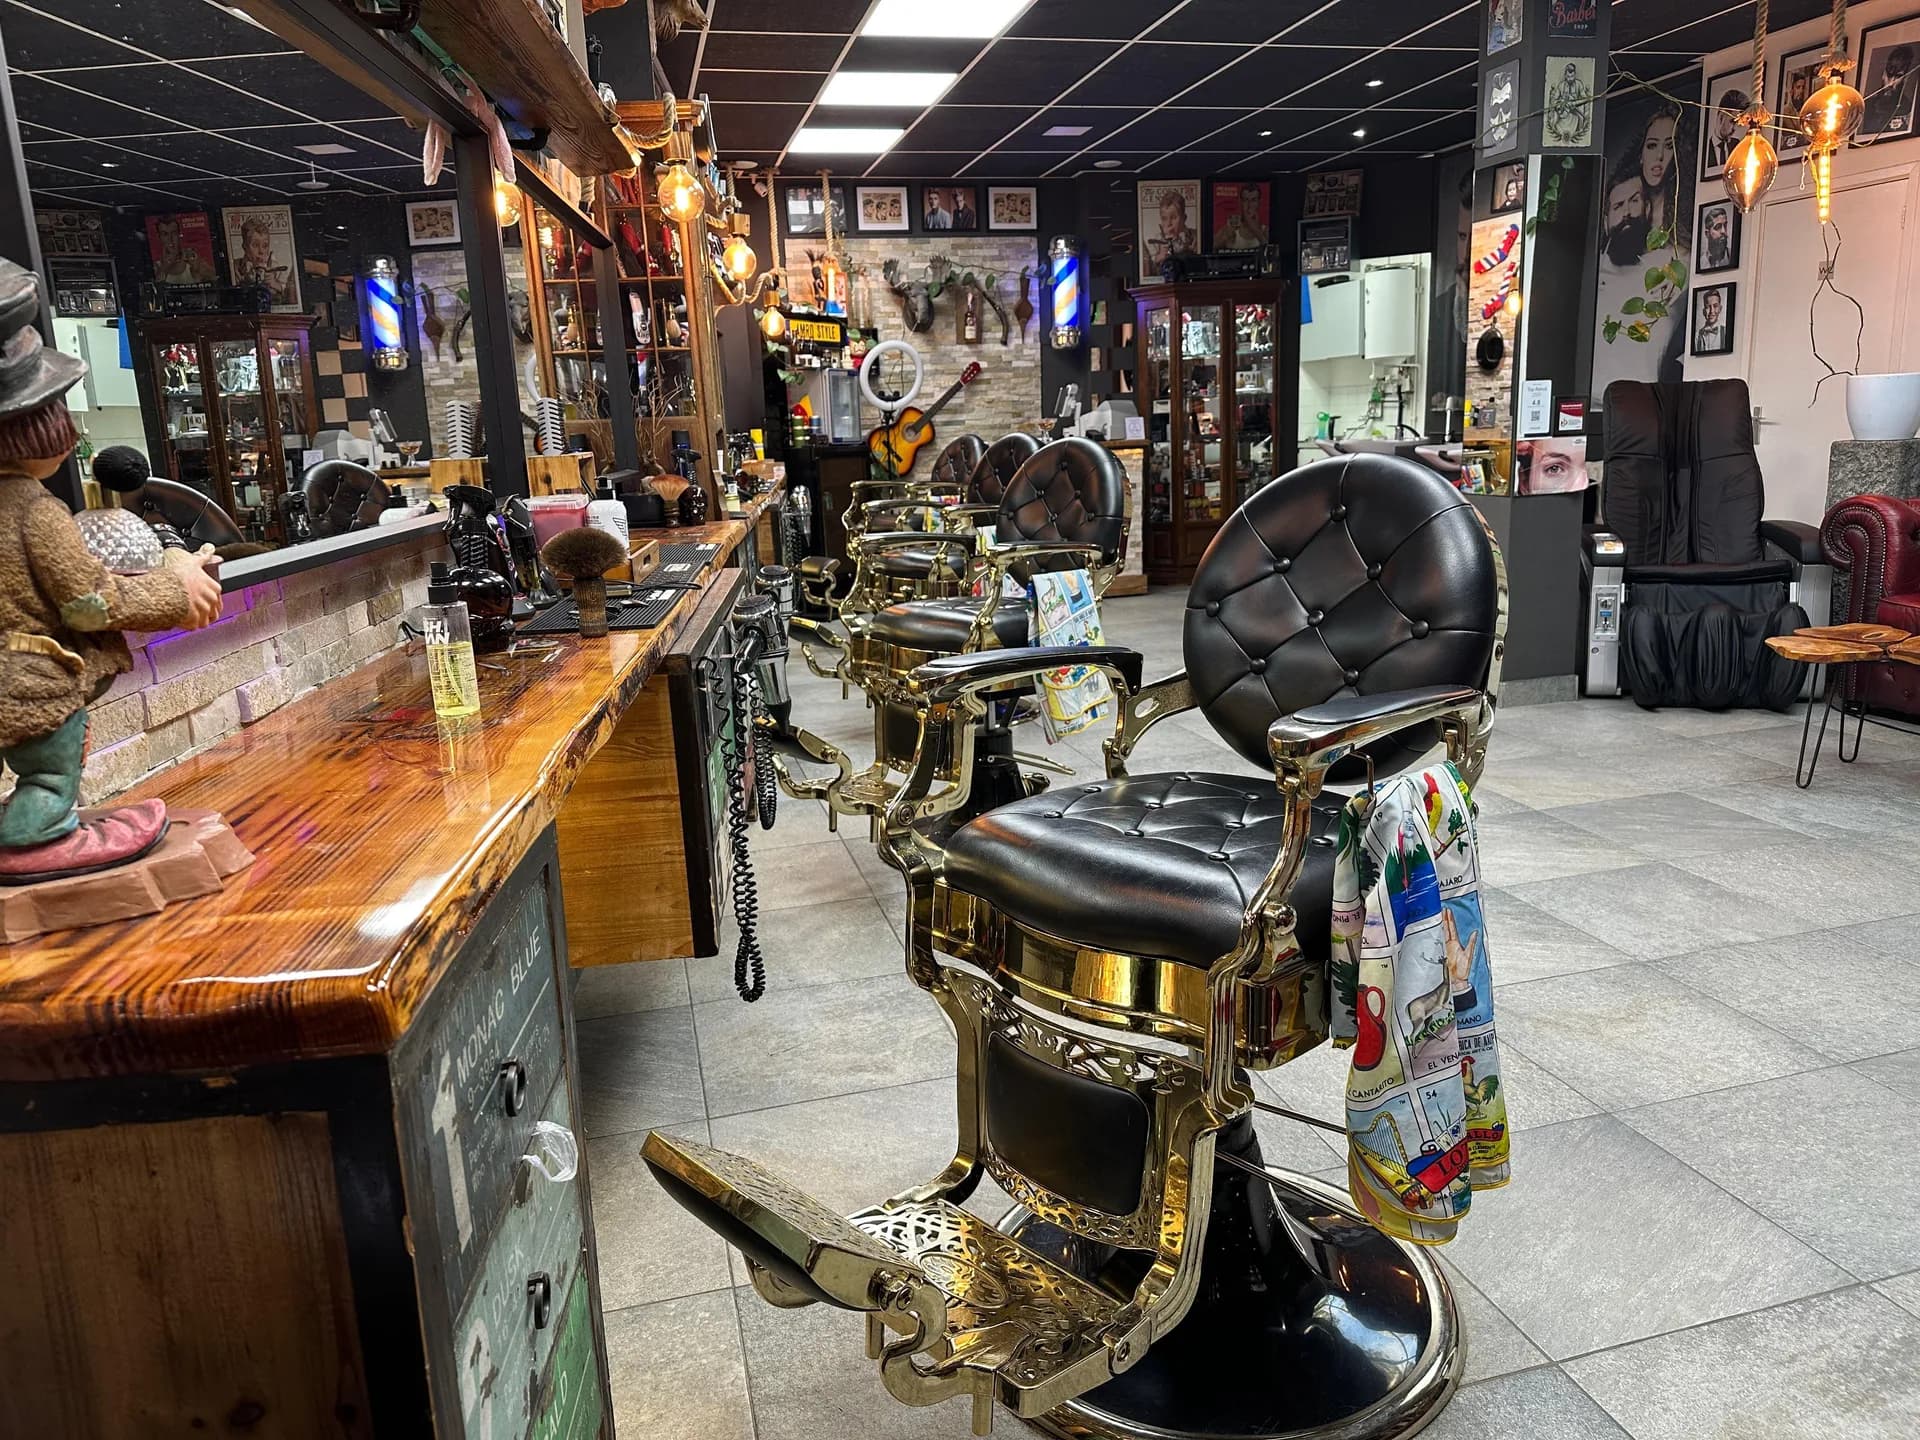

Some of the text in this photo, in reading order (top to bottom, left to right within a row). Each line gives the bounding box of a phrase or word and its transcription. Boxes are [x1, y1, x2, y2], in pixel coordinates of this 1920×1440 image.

[817, 325, 836, 340] STYLE
[1374, 811, 1383, 822] 19
[1440, 874, 1463, 888] AJARO
[456, 987, 505, 1089] MONAC
[510, 925, 542, 996] BLUE
[1427, 1062, 1438, 1070] EL
[1352, 1077, 1395, 1098] CANTARITO
[1425, 1089, 1438, 1100] 54
[492, 1232, 524, 1329] DUSK
